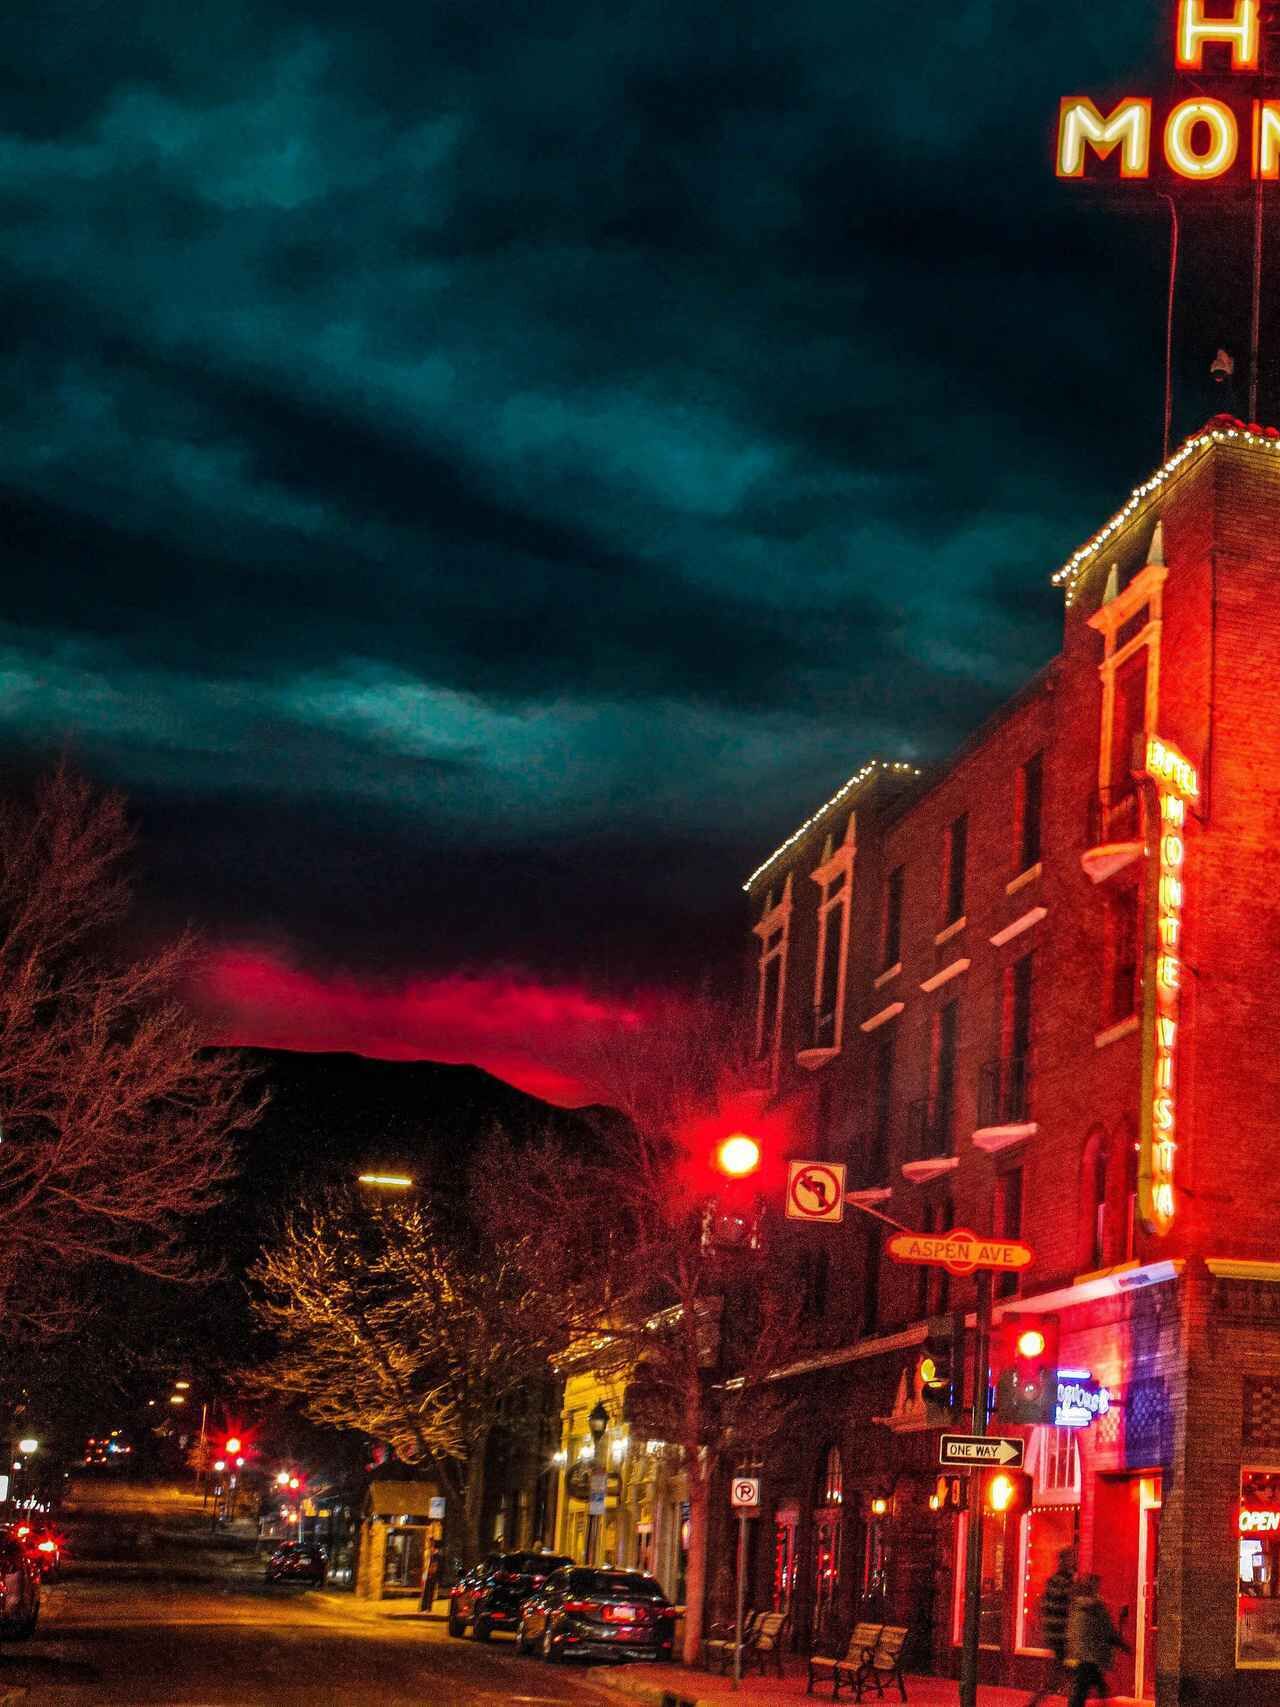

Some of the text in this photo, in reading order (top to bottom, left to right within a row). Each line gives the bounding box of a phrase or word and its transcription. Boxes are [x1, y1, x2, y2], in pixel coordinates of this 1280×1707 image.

[1153, 796, 1184, 1217] MONTE VISTA
[910, 1240, 1014, 1264] ASPEN AVE
[950, 1444, 998, 1457] ONE WAY
[1239, 1511, 1280, 1531] OPEN
